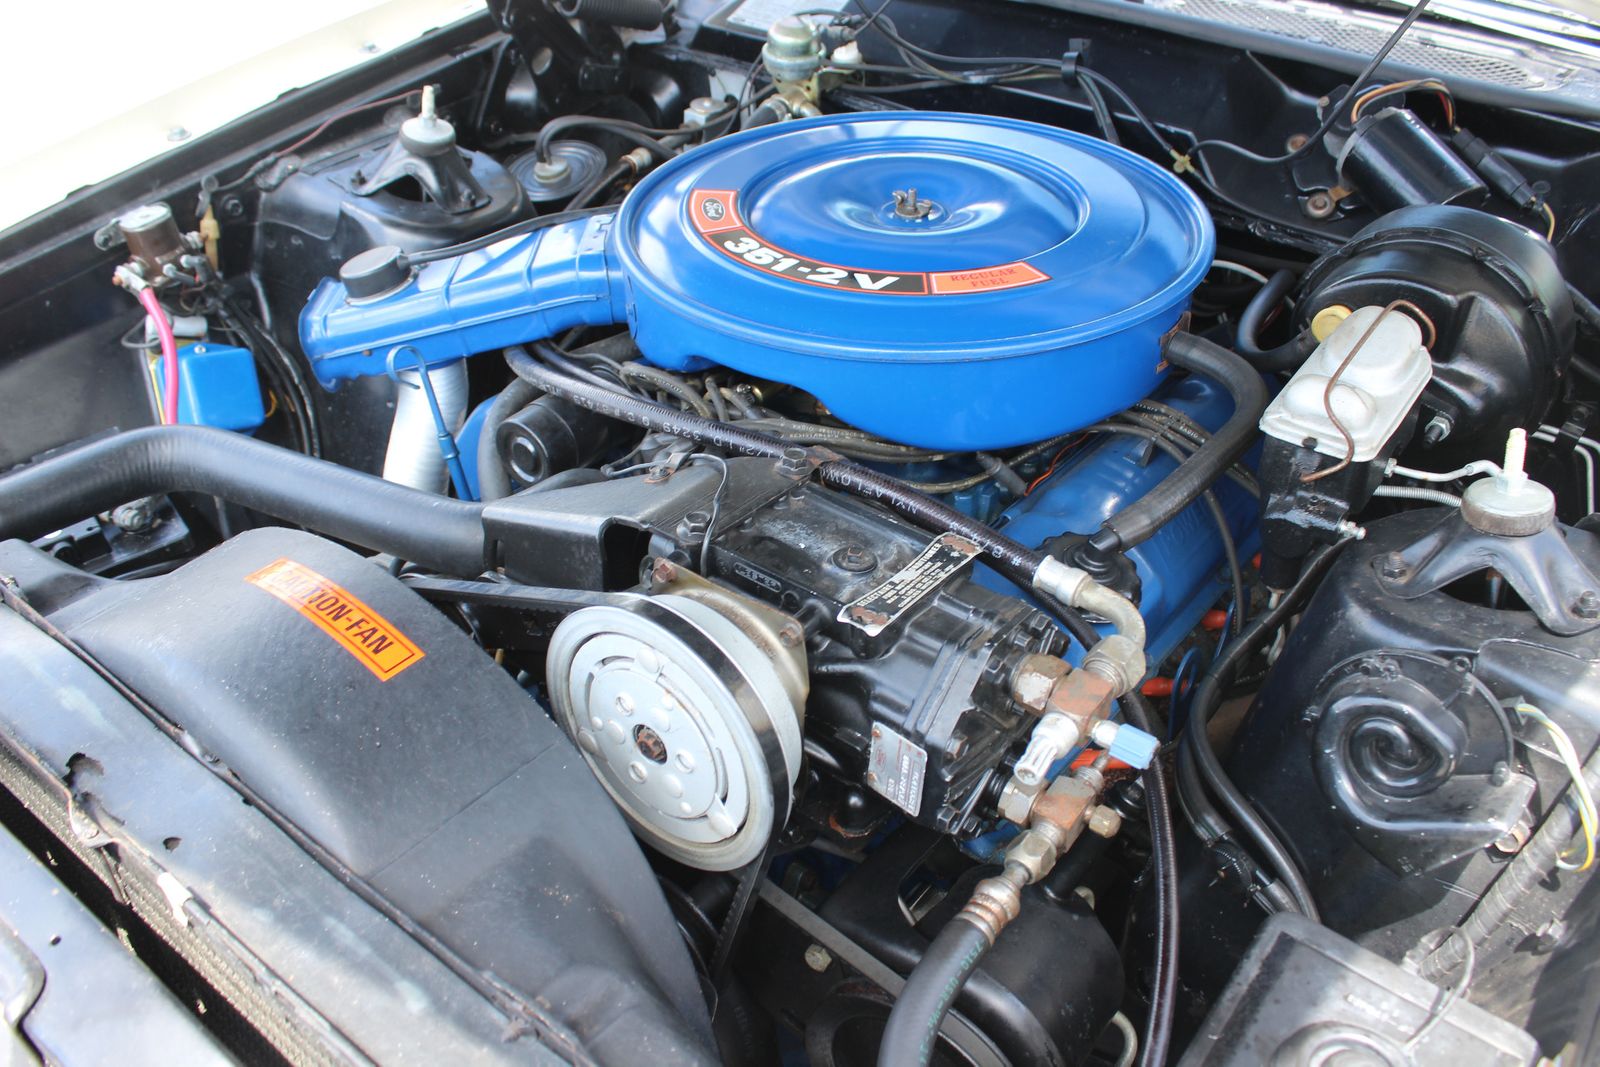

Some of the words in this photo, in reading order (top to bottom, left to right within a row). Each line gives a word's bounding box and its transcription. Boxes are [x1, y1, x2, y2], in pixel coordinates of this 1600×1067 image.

[723, 237, 900, 291] 351-2V
[950, 268, 1017, 282] REGULAR
[971, 278, 1009, 287] FUEL
[662, 421, 701, 441] 3249
